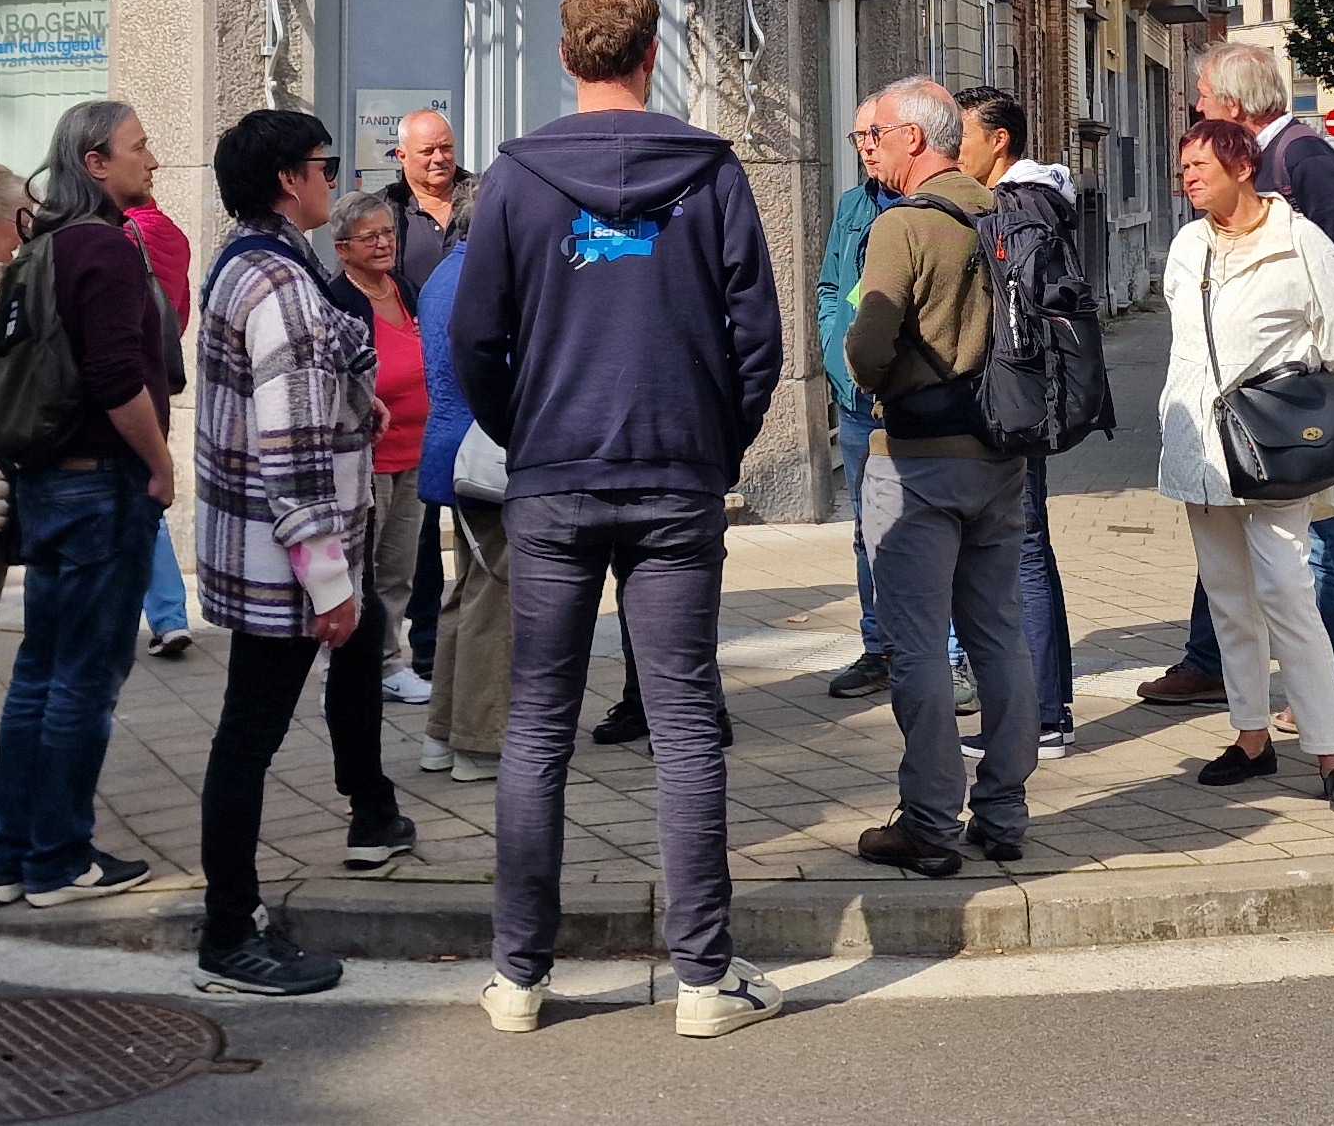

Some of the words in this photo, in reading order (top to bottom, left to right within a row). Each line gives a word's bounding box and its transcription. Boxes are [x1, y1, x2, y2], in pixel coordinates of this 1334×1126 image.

[45, 10, 106, 32] GENT
[19, 37, 101, 56] kunstgebit
[431, 100, 448, 111] 94
[593, 226, 636, 237] Screen
